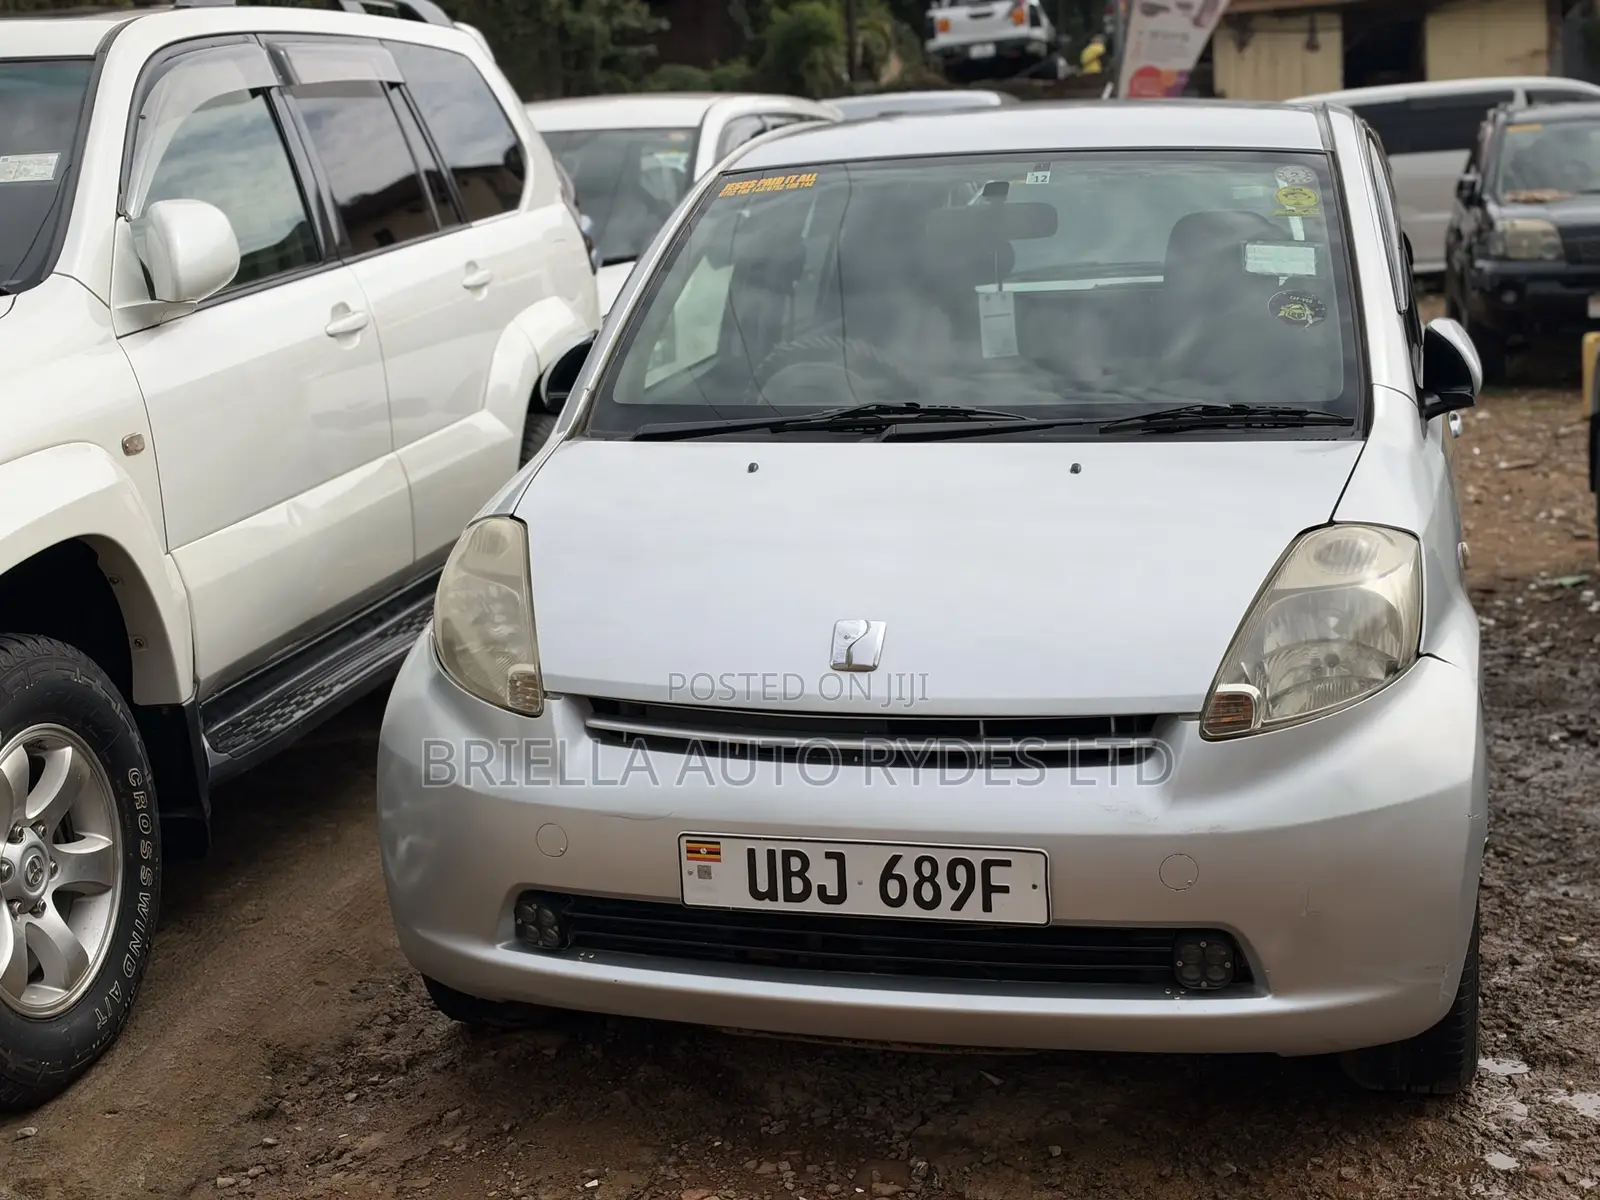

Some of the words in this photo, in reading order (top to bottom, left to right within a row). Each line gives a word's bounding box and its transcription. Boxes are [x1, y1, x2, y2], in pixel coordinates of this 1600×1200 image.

[786, 174, 799, 184] IT
[797, 173, 818, 183] ALL
[1034, 174, 1048, 183] 12
[123, 767, 153, 978] CROSSWIND
[746, 847, 848, 905] UBJ
[878, 854, 1012, 914] 689F
[94, 980, 124, 1030] A/T
